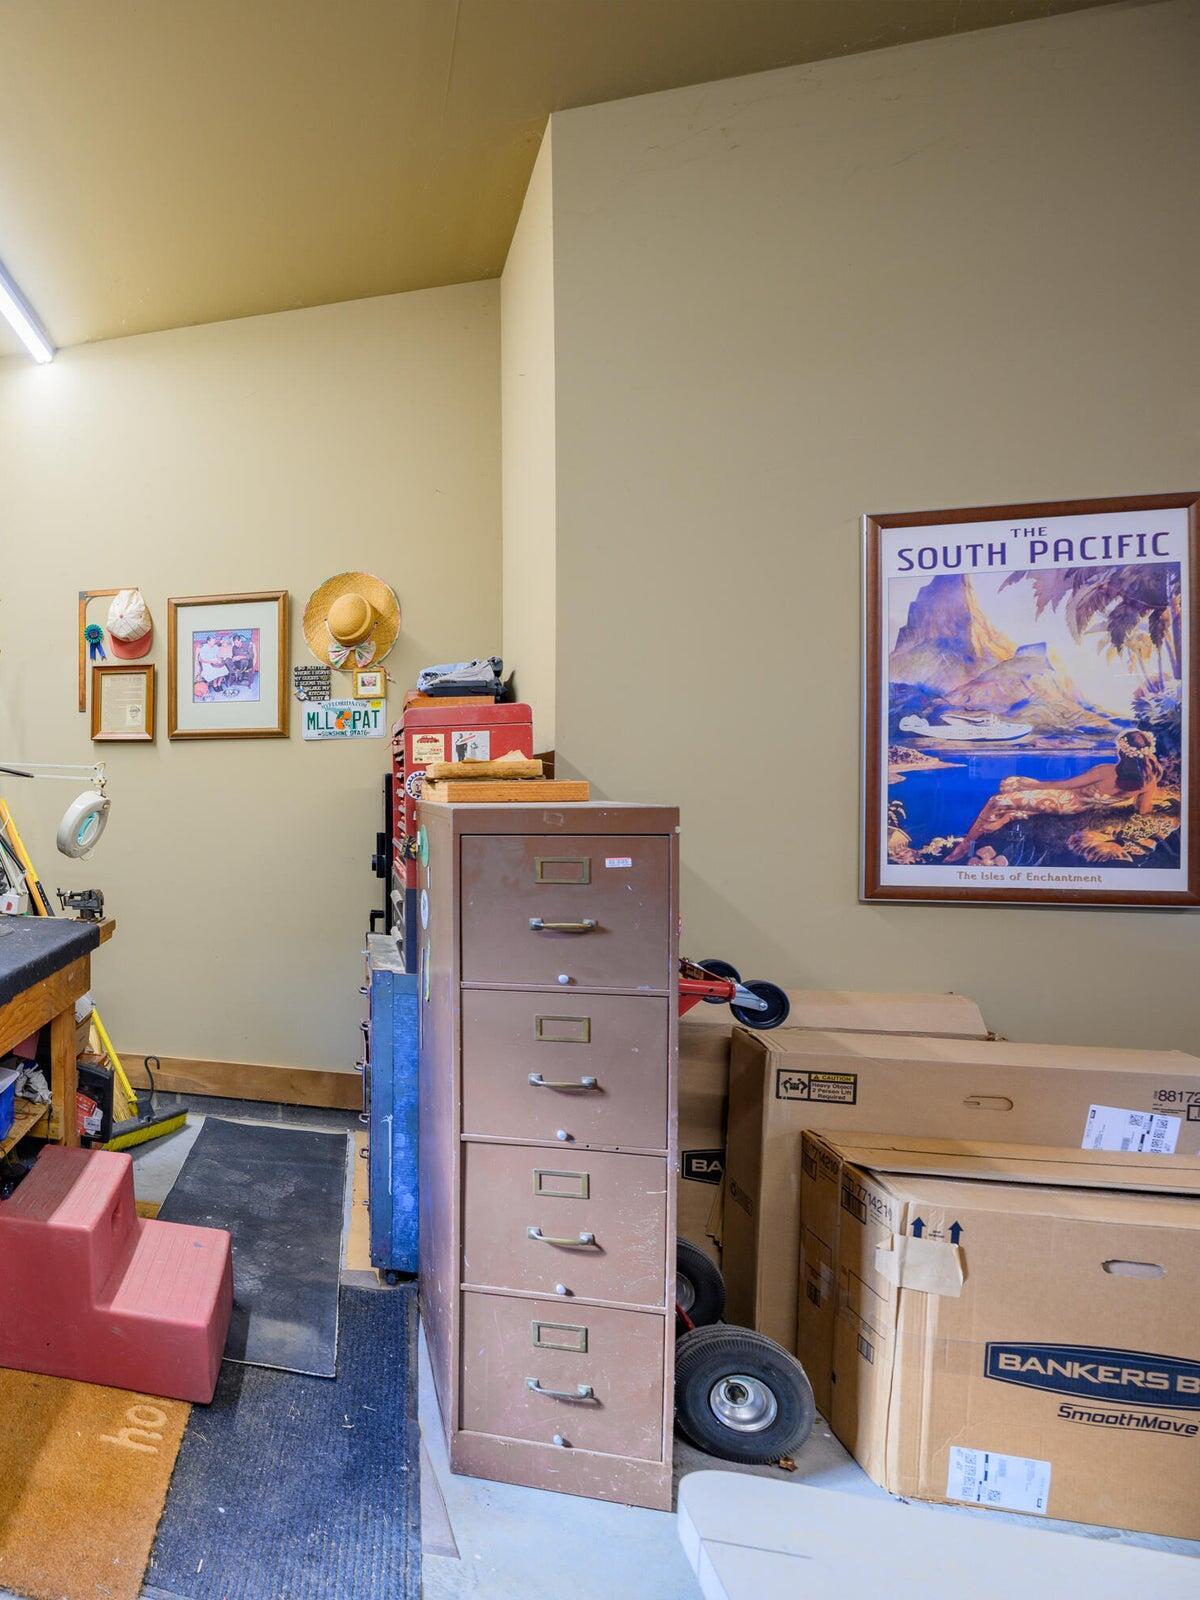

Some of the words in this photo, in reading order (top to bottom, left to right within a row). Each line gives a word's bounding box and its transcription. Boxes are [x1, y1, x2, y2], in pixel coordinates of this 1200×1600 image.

[1010, 526, 1048, 538] THE
[897, 542, 1007, 571] SOUTH
[1029, 531, 1171, 563] PACIFIC
[307, 711, 335, 730] MLL
[352, 709, 380, 729] PAT
[957, 871, 977, 880] The
[981, 872, 1005, 881] Isles
[1009, 872, 1022, 881] of
[1026, 873, 1103, 883] Enchantment
[998, 1353, 1170, 1390] BANKERS
[100, 1394, 174, 1454] ho
[1057, 1404, 1199, 1436] SmoothMove
